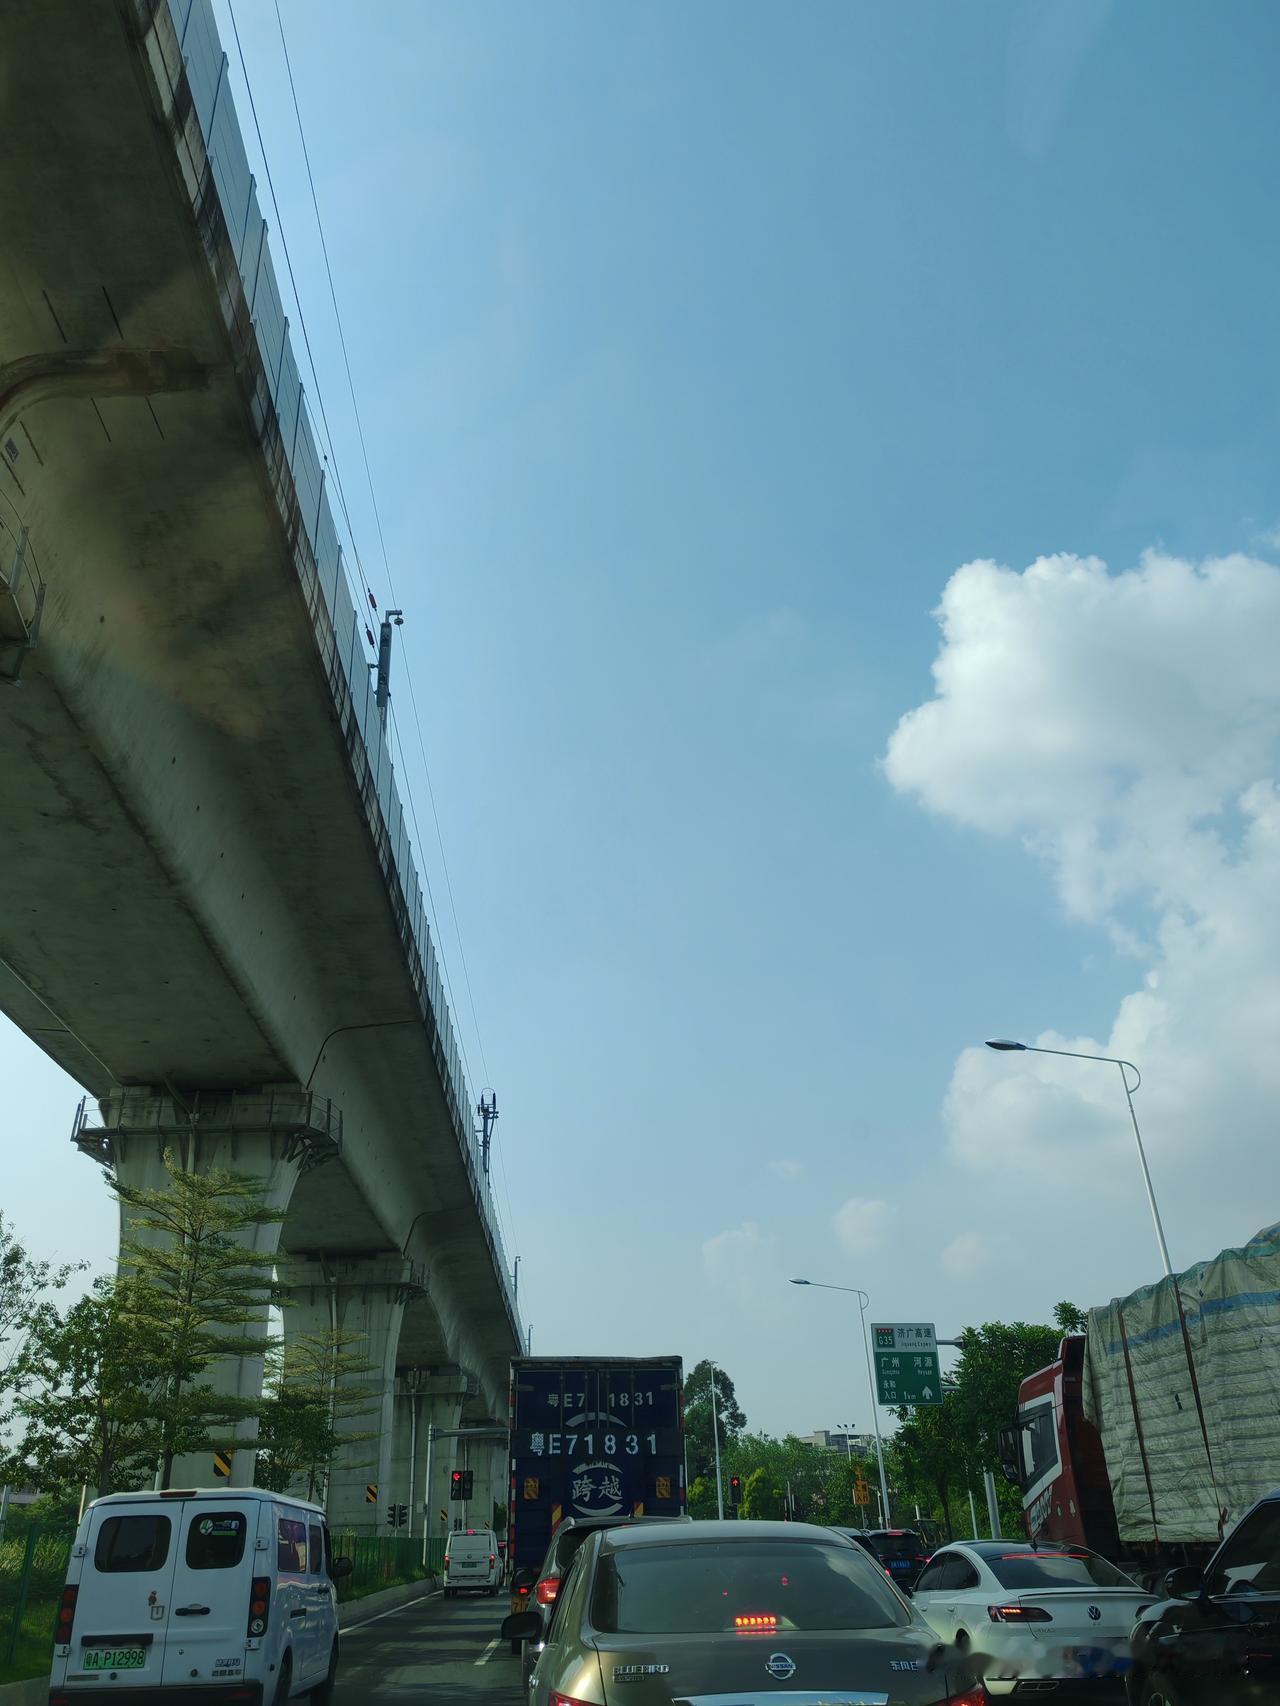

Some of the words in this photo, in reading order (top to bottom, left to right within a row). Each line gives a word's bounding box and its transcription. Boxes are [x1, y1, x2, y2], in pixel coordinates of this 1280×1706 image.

[878, 1335, 893, 1345] G35
[881, 1356, 900, 1368] 广州
[529, 1431, 657, 1457] 粤E71831
[571, 1475, 623, 1502] 跨越
